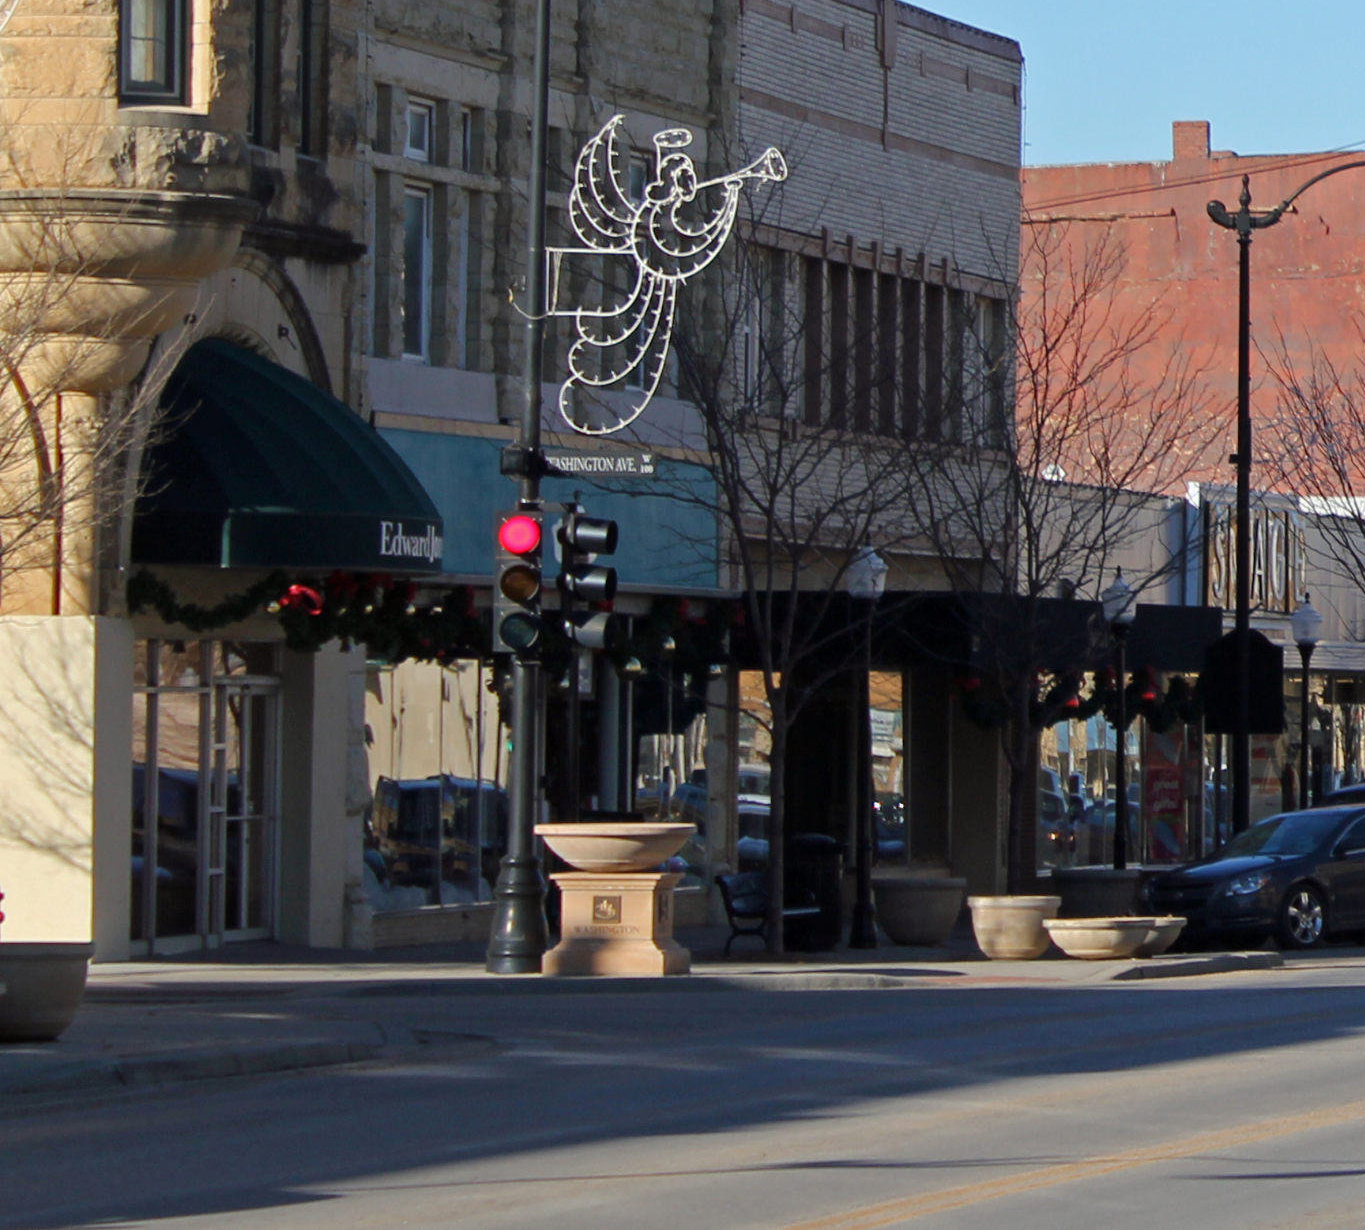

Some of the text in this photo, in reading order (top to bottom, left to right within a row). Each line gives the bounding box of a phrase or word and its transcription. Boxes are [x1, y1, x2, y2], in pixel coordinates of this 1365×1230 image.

[642, 453, 652, 463] W
[640, 464, 654, 474] 100
[574, 925, 640, 934] WASHINGTON
